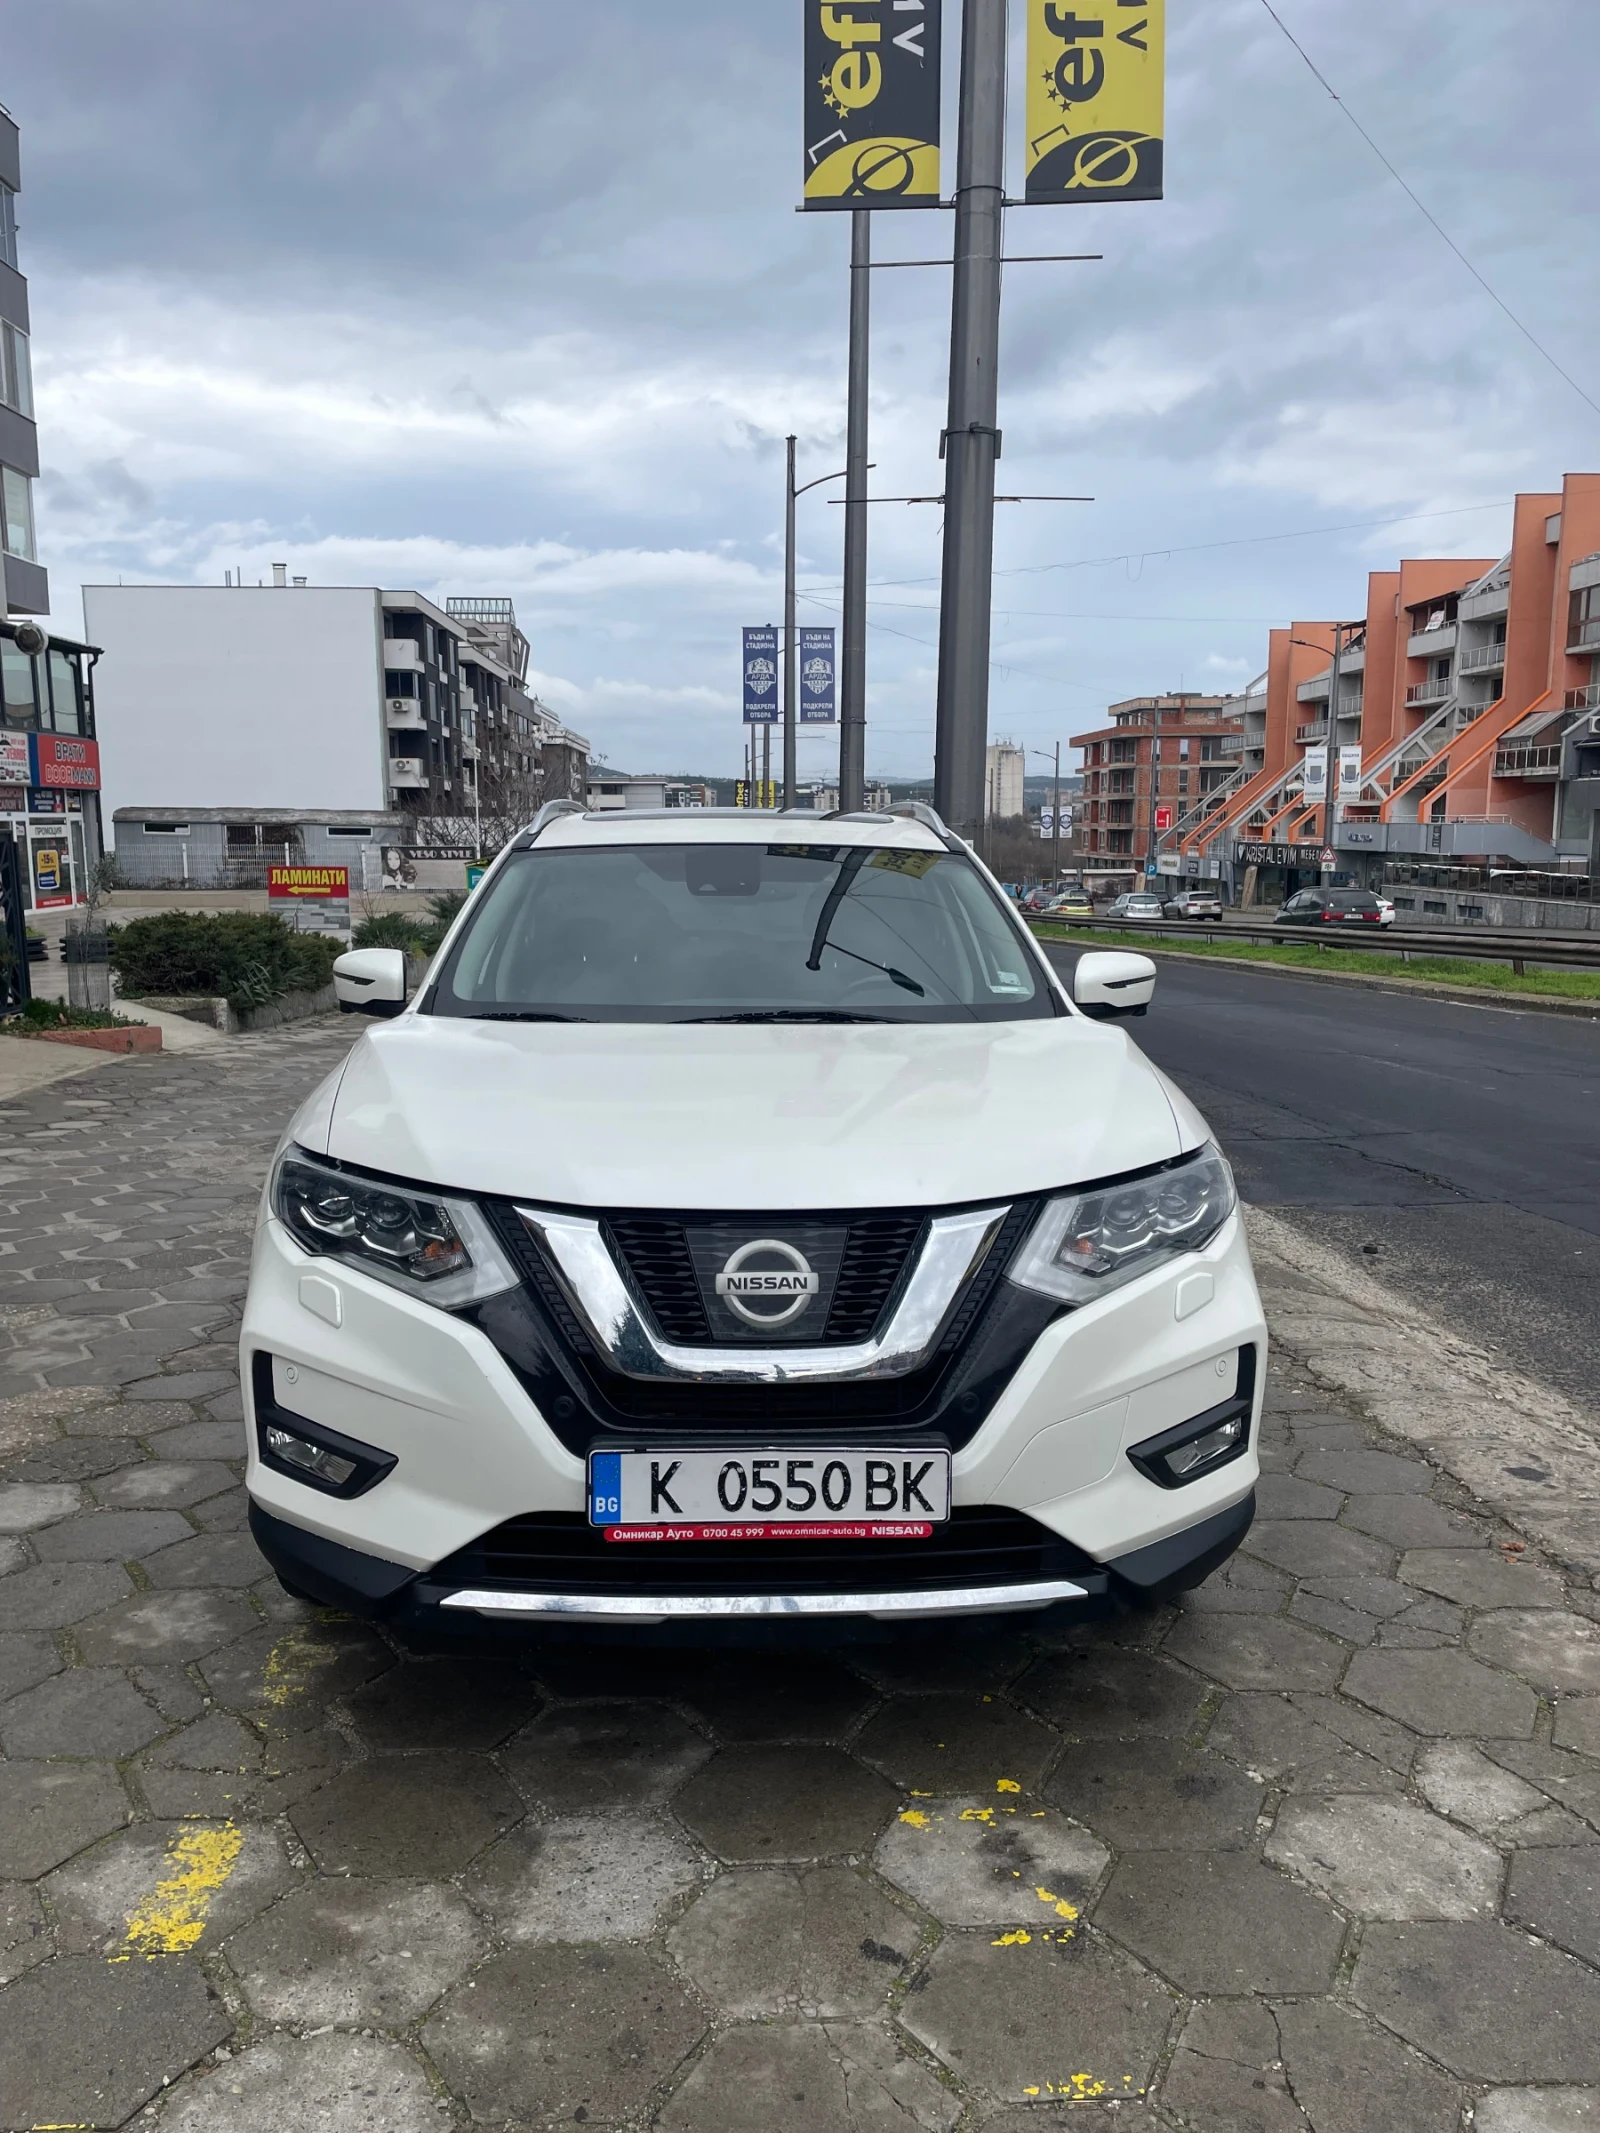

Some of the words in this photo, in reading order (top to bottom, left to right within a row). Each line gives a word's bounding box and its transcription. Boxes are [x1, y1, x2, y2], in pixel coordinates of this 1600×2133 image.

[819, 0, 882, 109] ef
[748, 633, 765, 641] БЪДИ
[766, 633, 774, 641] НА
[805, 633, 822, 641] БЪДИ
[745, 703, 775, 711] ПОДКРЕПИ
[802, 702, 833, 710] ПОДКРЕПИ
[54, 740, 86, 763] ВРАТИ
[44, 763, 96, 785] DOORMANN
[35, 826, 62, 835] ПРОМОЦИЯ
[409, 849, 437, 859] VESO
[440, 849, 473, 859] STYLE
[1246, 845, 1275, 864] KRISTAL
[271, 868, 346, 885] ЛАМИНАТИ
[1148, 865, 1155, 875] P
[727, 1277, 808, 1290] NISSAN
[651, 1461, 684, 1514] K
[718, 1460, 851, 1513] 0550
[865, 1460, 935, 1513] BK
[595, 1496, 618, 1513] BG
[613, 1529, 664, 1541] Омникар
[666, 1529, 694, 1539] Ауто
[702, 1529, 728, 1538] 0700
[730, 1529, 743, 1537] 45
[746, 1528, 765, 1537] 999
[771, 1527, 866, 1538] www.omnicar-auto.bg
[871, 1526, 924, 1536] NISSAN
